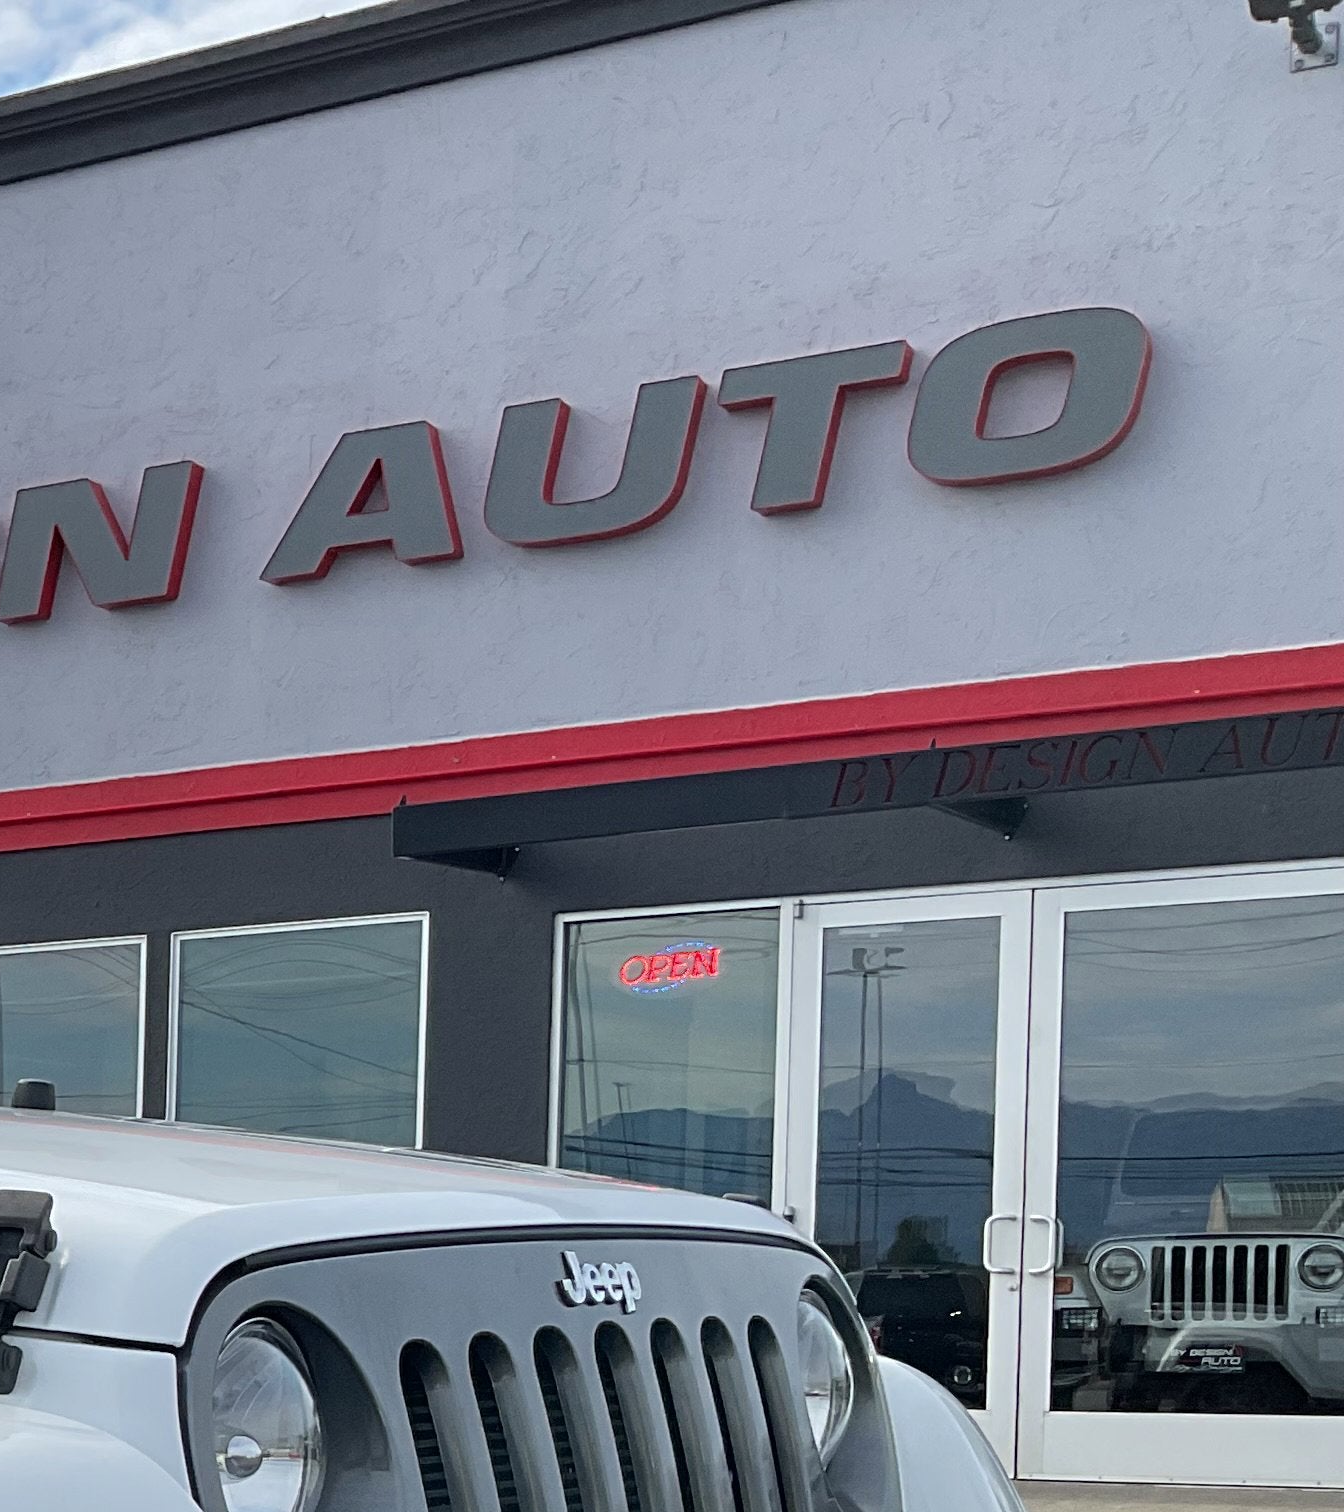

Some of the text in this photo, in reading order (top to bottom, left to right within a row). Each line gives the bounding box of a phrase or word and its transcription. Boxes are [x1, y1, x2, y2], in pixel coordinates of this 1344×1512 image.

[259, 306, 1153, 586] AUTO
[829, 754, 918, 809] BY
[932, 728, 1180, 799] DESIGN
[619, 947, 721, 986] OPEN
[555, 1250, 642, 1315] Jeep
[1200, 1356, 1242, 1365] AUTO
